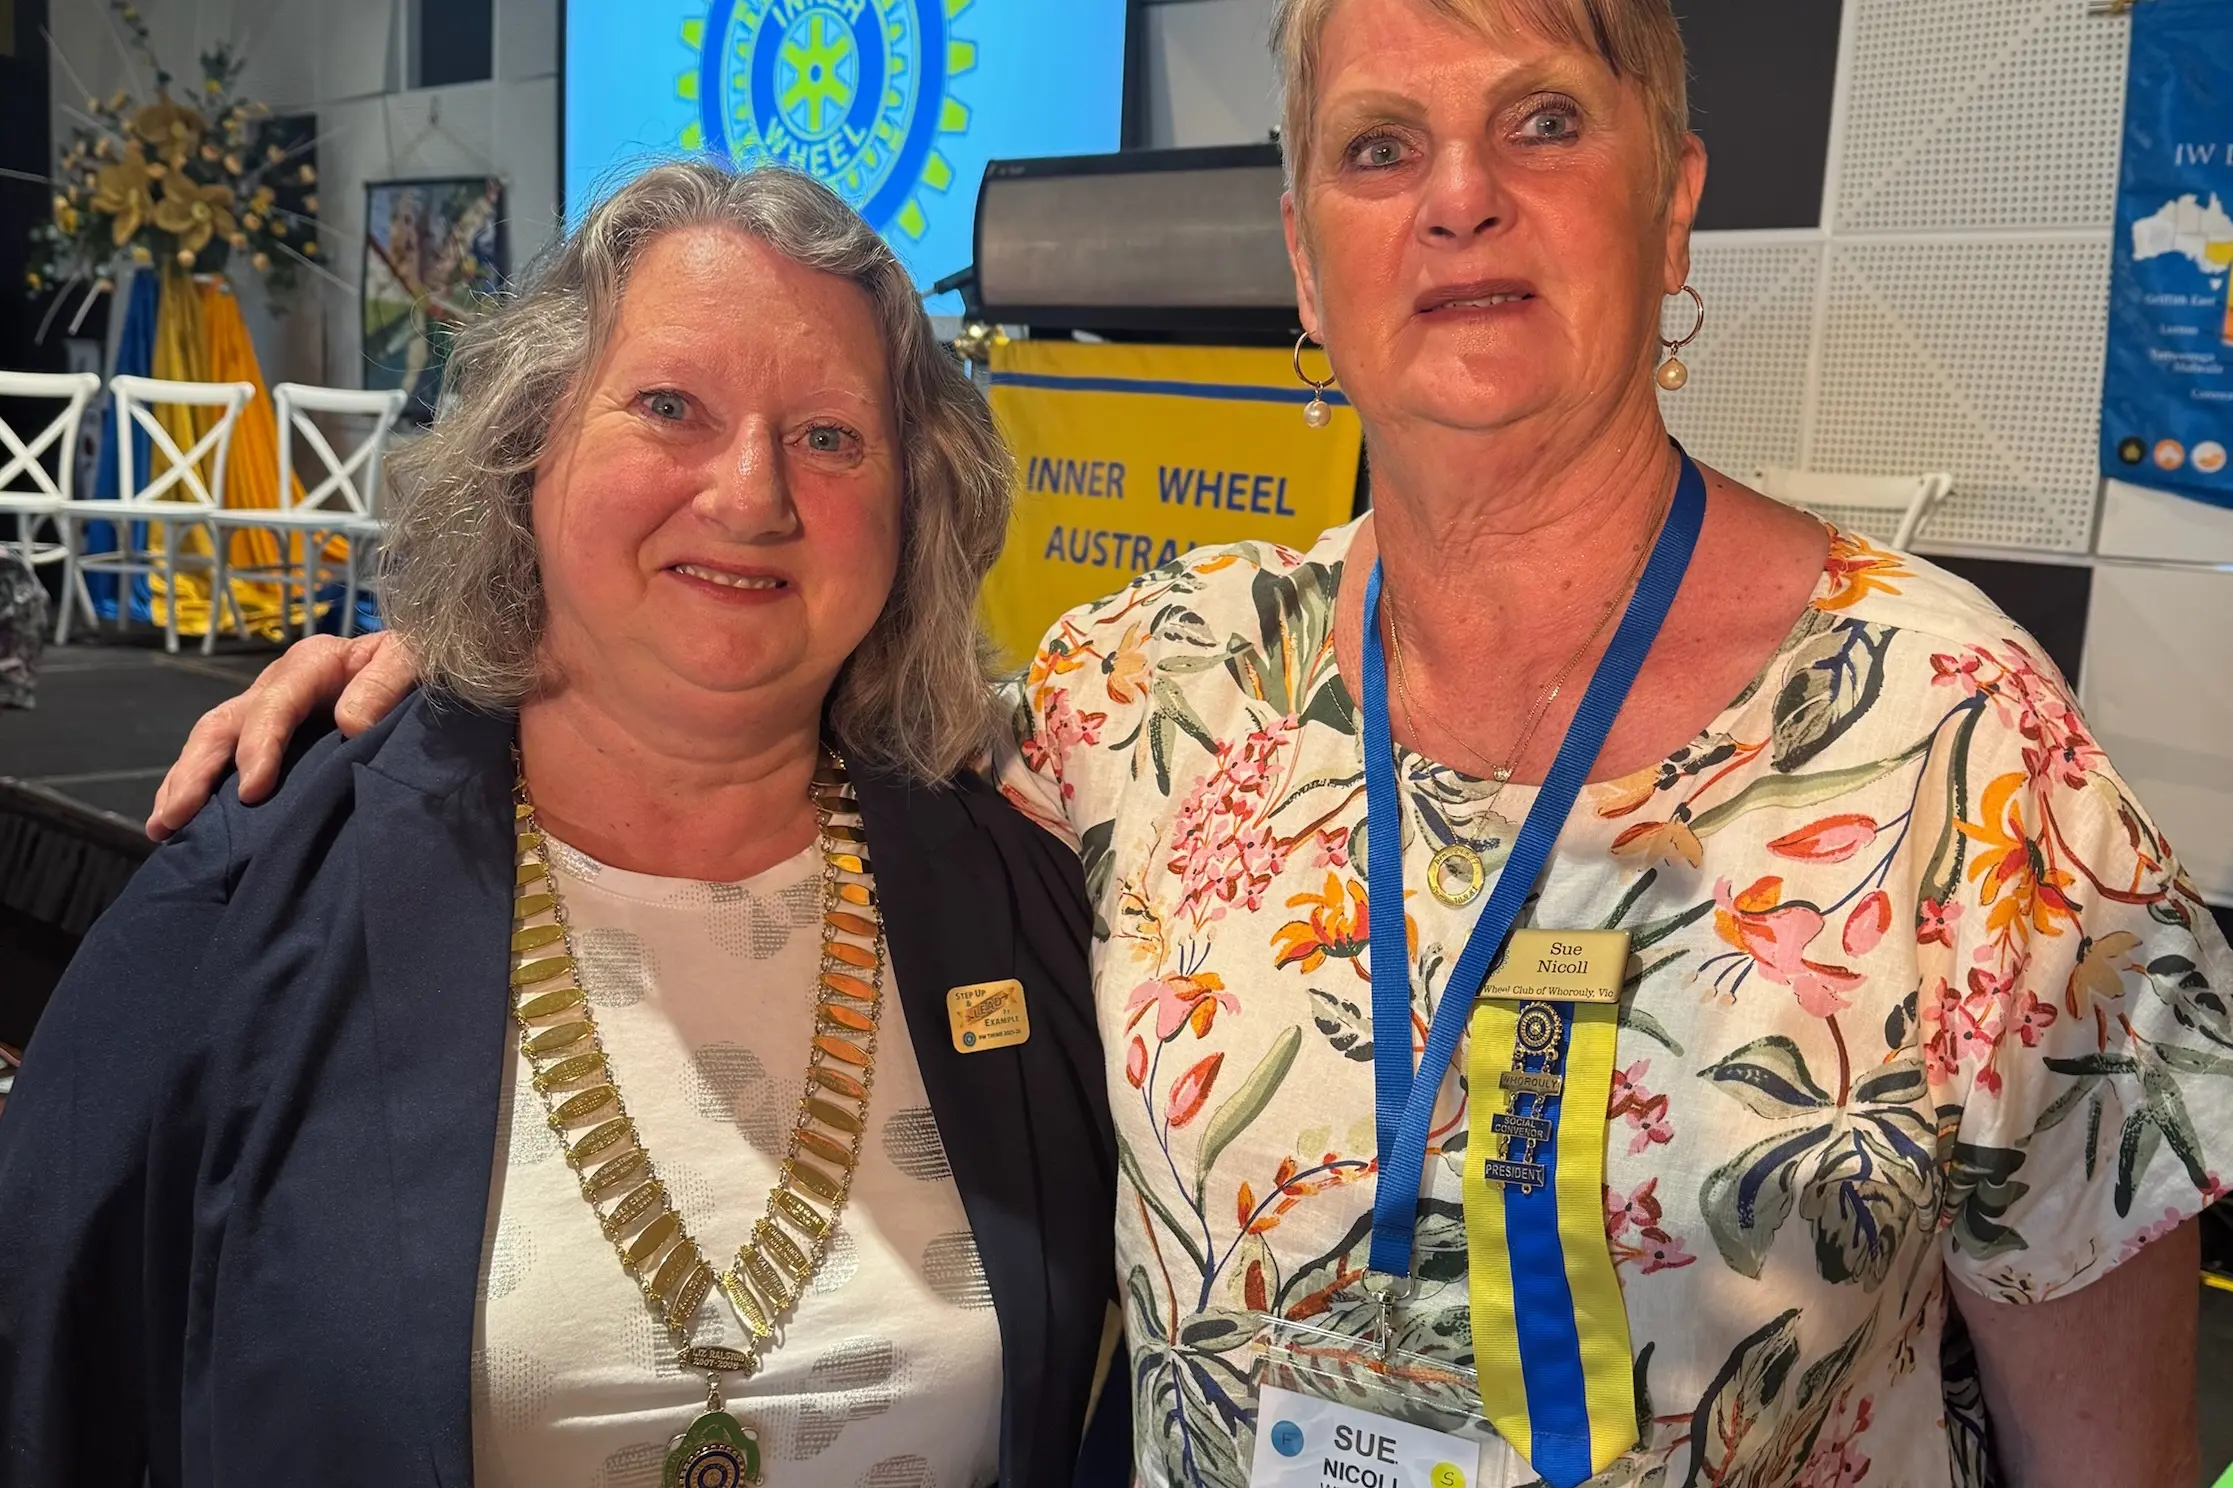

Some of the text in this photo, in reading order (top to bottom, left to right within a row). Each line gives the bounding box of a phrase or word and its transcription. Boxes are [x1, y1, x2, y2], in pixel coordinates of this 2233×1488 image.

[765, 117, 867, 176] WHEEL
[1027, 455, 1296, 517] INNER WHEEL
[1550, 942, 1582, 956] Sue
[1537, 959, 1588, 974] Nicoll
[1512, 986, 1534, 994] Club
[1536, 987, 1546, 995] of
[1504, 1075, 1557, 1090] WHOROULY
[1504, 1116, 1536, 1128] SOCIAL
[1495, 1123, 1543, 1138] CONVENOR
[1486, 1164, 1541, 1183] PRESIDENT
